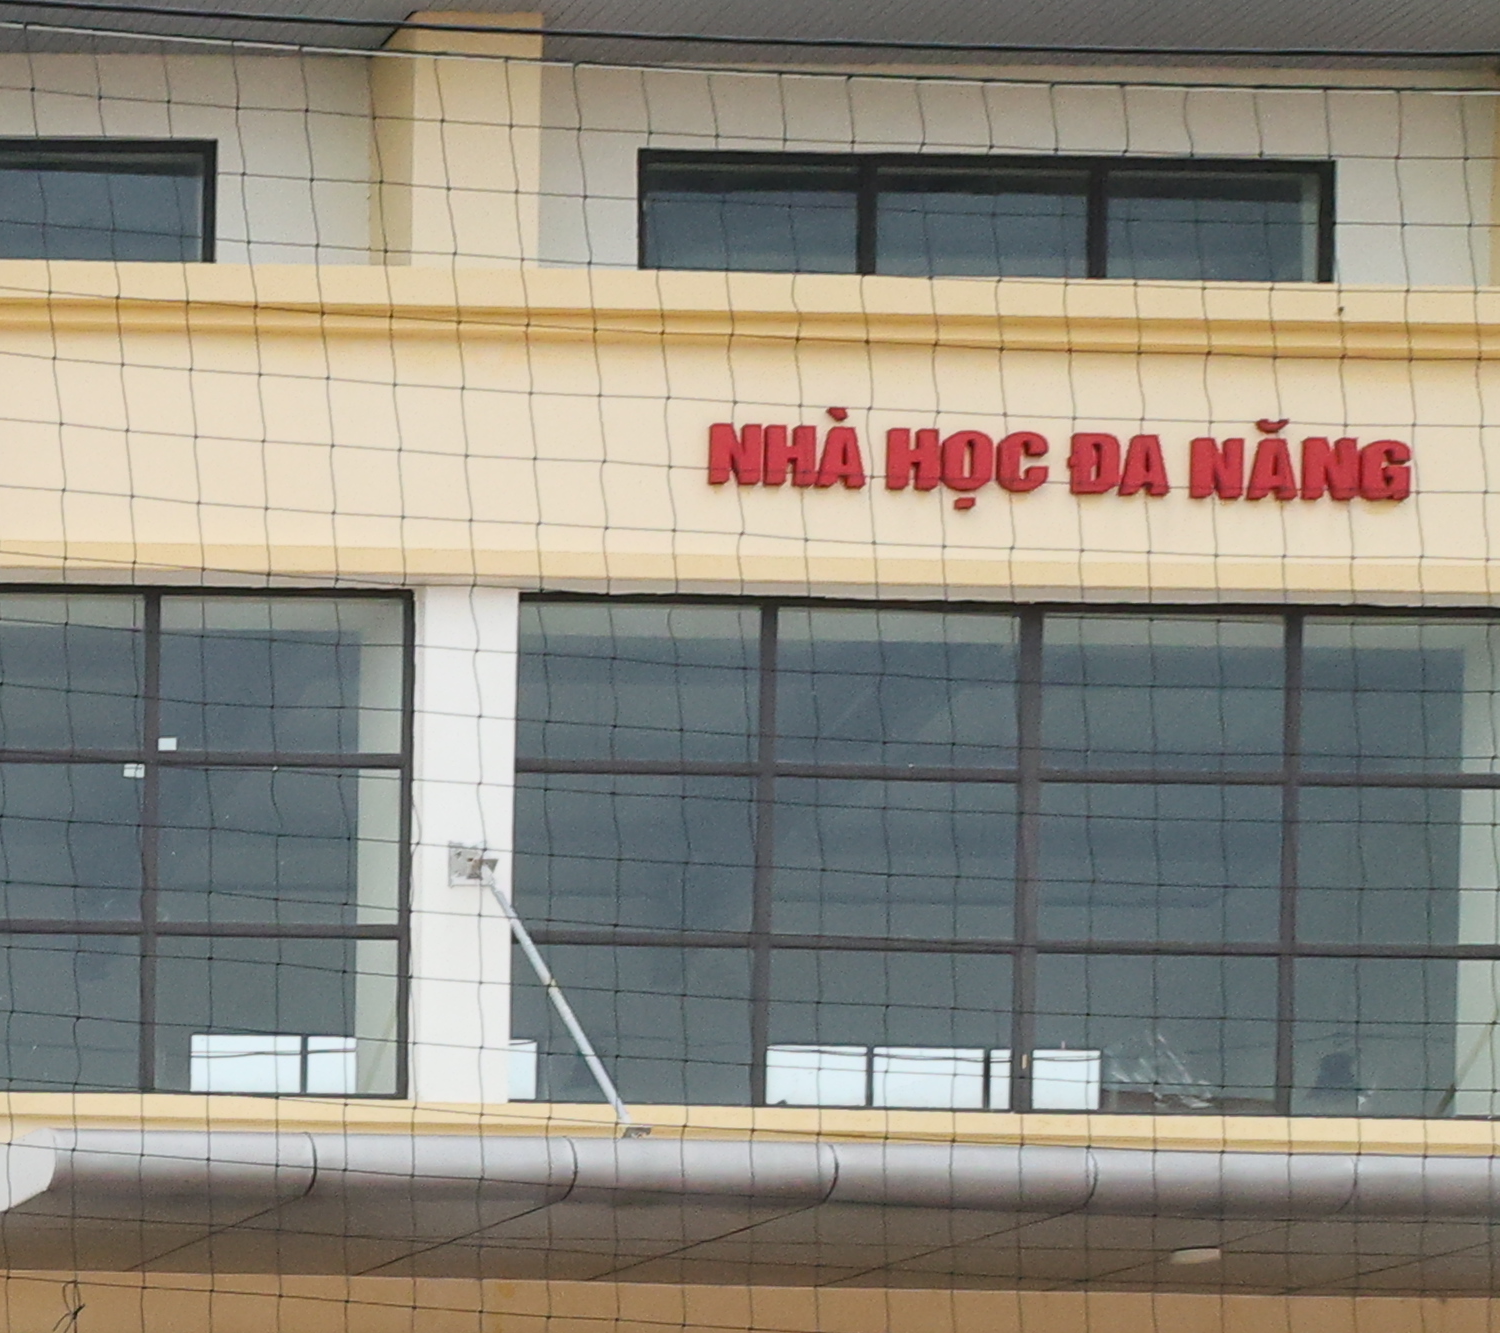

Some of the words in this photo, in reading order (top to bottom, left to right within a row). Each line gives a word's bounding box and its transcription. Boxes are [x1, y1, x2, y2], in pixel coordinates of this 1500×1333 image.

[708, 407, 866, 490] NHÀ
[886, 427, 1049, 510] HỌC
[1068, 433, 1169, 497] ĐA
[1189, 418, 1412, 501] NĂNG
